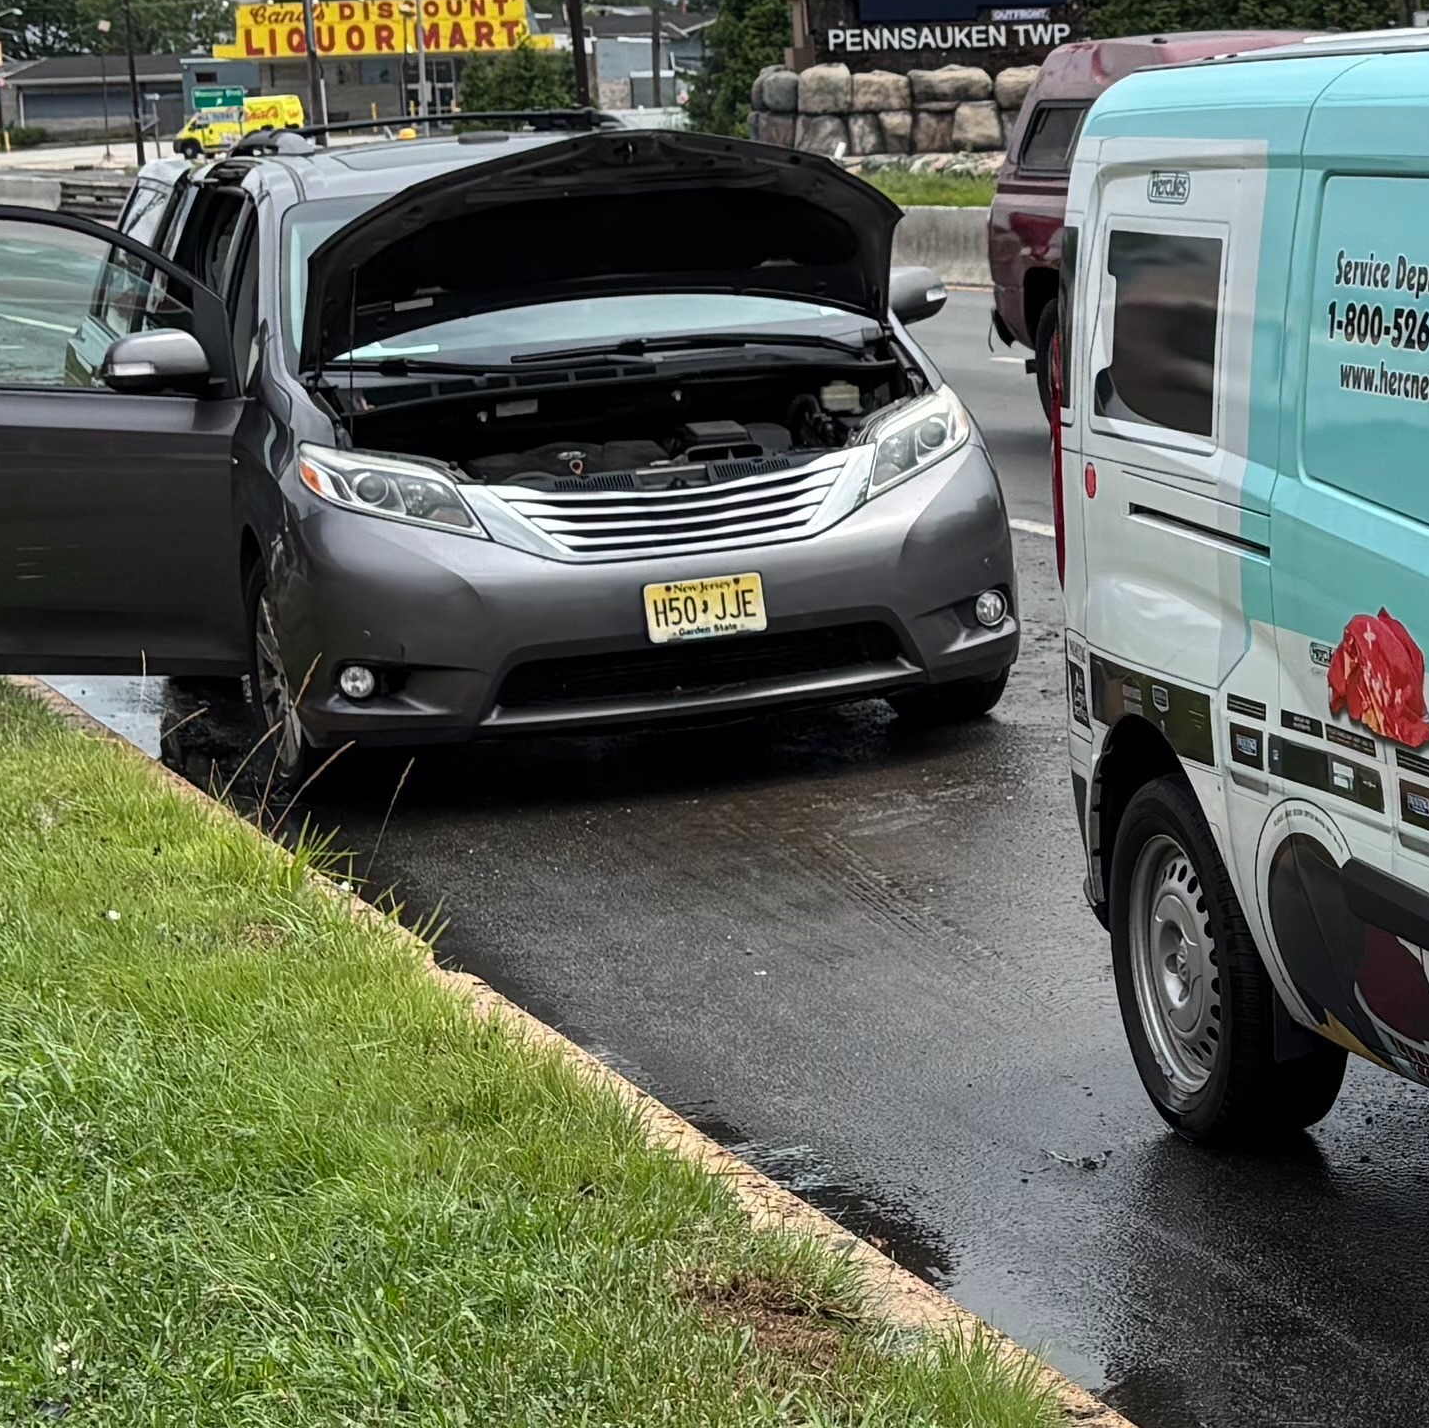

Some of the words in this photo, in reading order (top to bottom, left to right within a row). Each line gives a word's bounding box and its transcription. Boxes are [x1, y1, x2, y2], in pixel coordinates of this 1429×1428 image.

[244, 24, 395, 56] LIQUOR
[414, 20, 521, 50] MART
[828, 24, 1007, 52] PENNSAUKEN
[1013, 23, 1071, 47] TWP
[1335, 249, 1391, 290] Service
[673, 583, 697, 594] New
[698, 580, 732, 593] Jersey
[653, 595, 698, 628] H50
[714, 589, 758, 621] JJE
[678, 625, 711, 637] Garden
[714, 623, 738, 634] State
